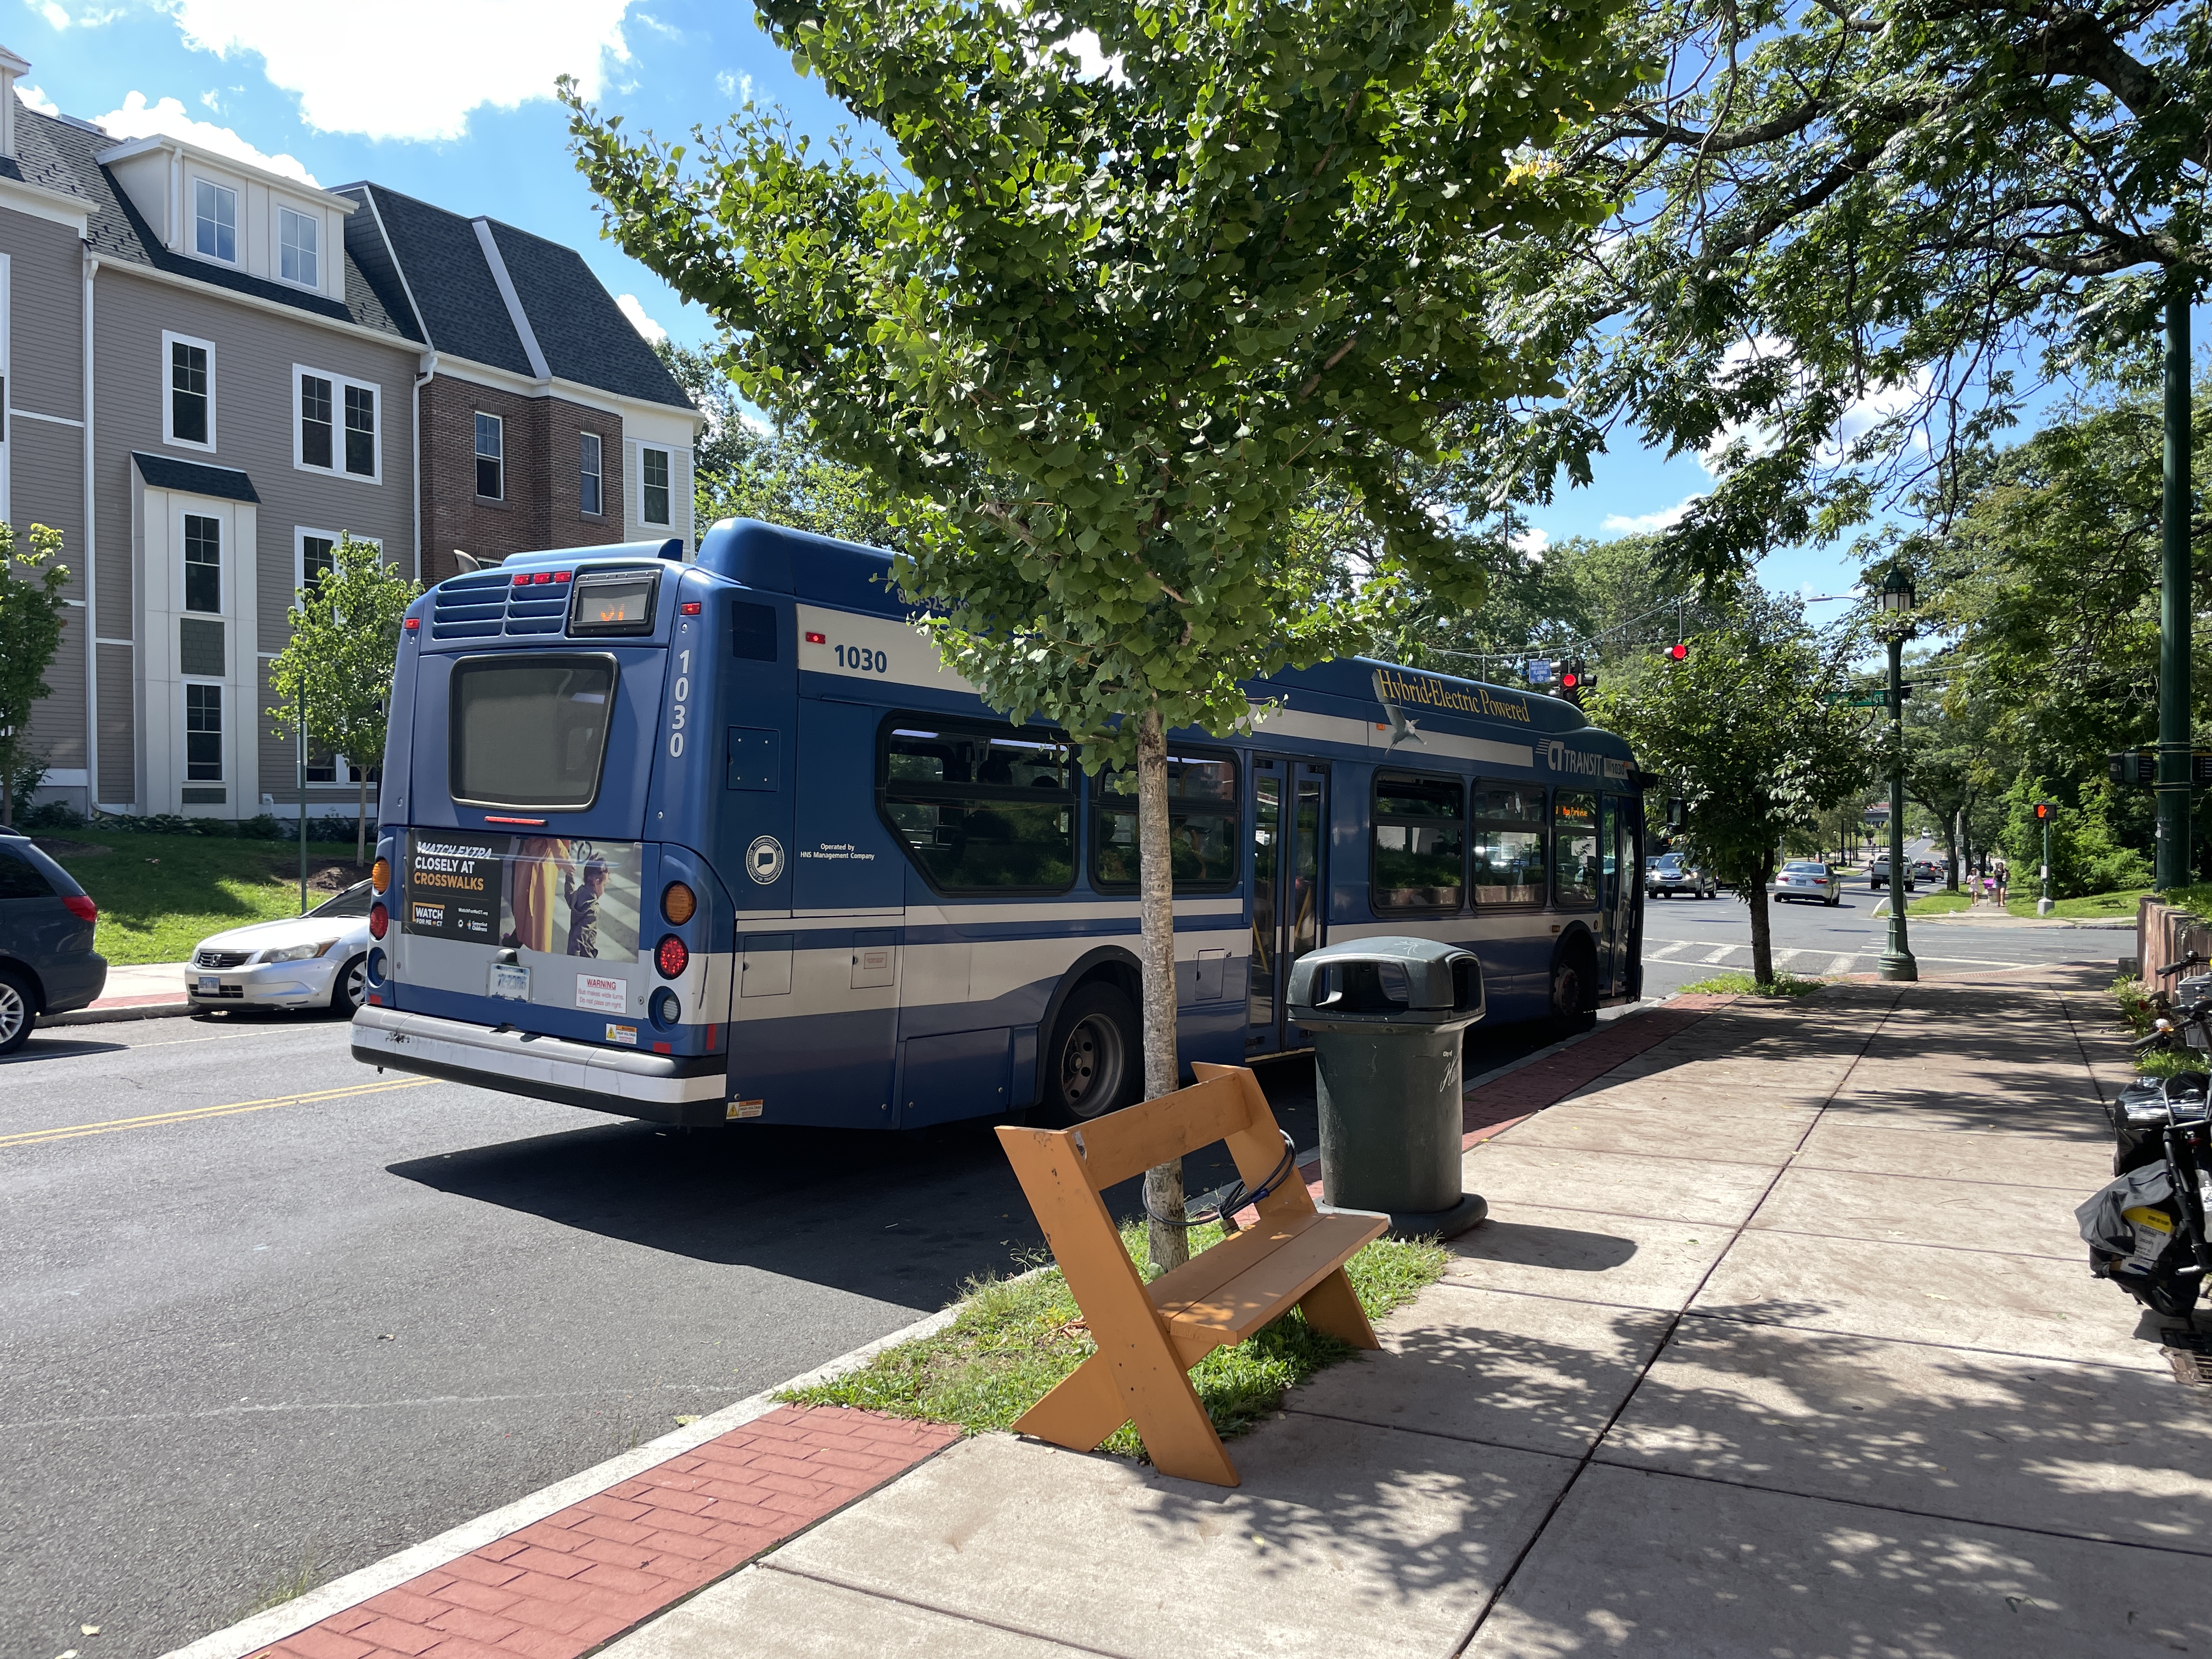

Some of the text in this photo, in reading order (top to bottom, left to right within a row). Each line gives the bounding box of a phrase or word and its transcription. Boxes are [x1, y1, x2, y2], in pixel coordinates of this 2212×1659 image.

[834, 645, 887, 673] 1030
[670, 649, 690, 758] 1030
[1375, 668, 1531, 723] Hybrid-Electric Powered
[1564, 749, 1602, 776] TRANSIT
[1611, 762, 1624, 776] 1030
[1571, 806, 1580, 816] Park
[417, 841, 492, 859] WATCH EXTRA
[813, 851, 849, 860] Management
[850, 852, 875, 861] Company
[820, 843, 855, 851] Operated by
[415, 856, 475, 874] CLOSELY AT
[414, 872, 484, 891] CROSSWALKS
[415, 907, 443, 920] WATCH
[586, 978, 616, 989] WARNING
